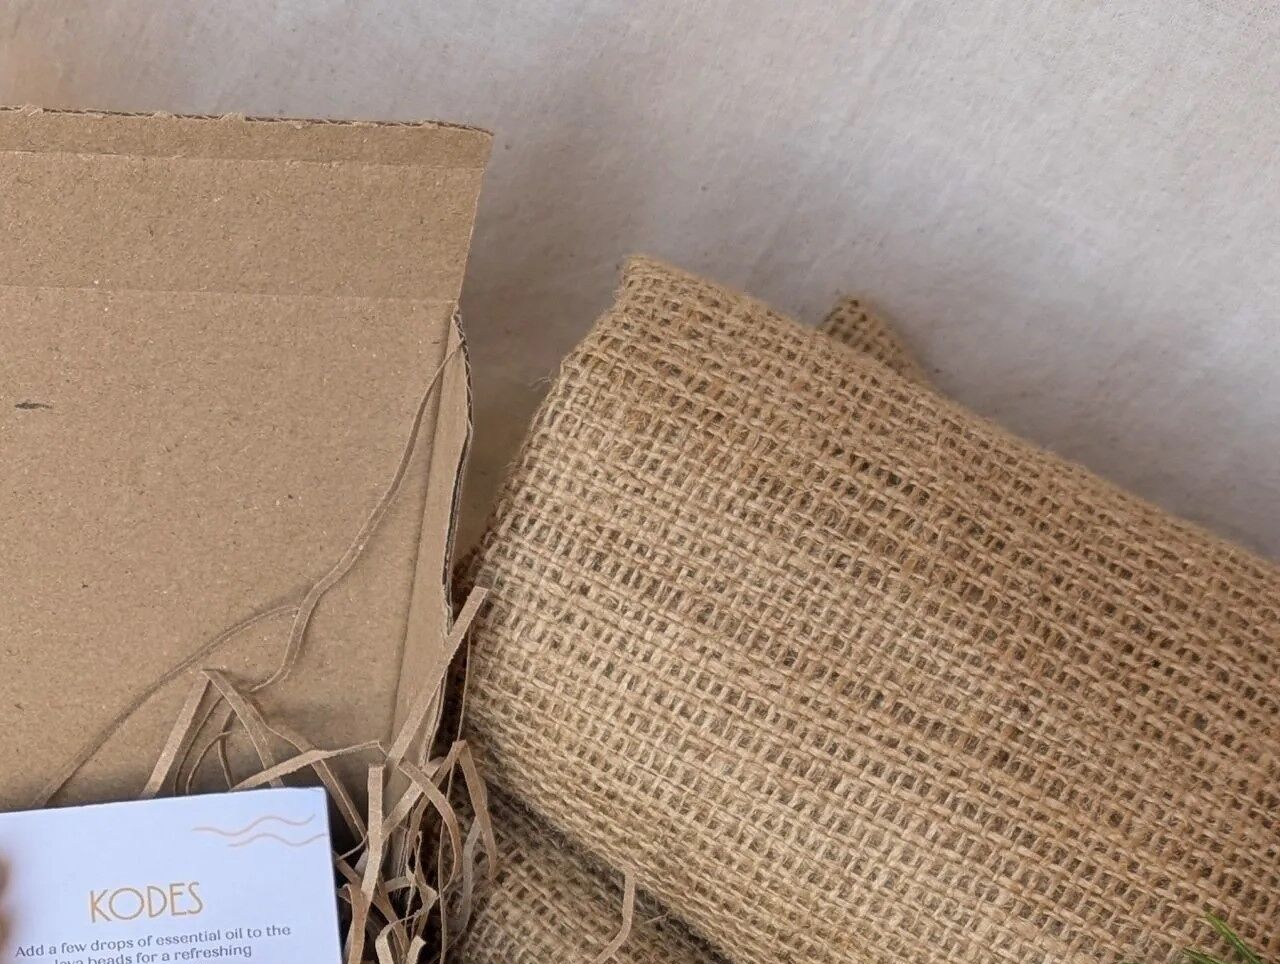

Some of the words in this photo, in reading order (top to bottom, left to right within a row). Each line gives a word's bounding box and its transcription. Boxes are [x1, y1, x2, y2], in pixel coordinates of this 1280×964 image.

[89, 880, 203, 923] KODES
[15, 944, 44, 956] Add
[48, 945, 56, 955] a
[61, 942, 87, 953] few
[90, 939, 133, 953] drops
[137, 934, 153, 947] of
[155, 928, 220, 945] essential
[225, 927, 242, 940] oil
[246, 928, 262, 938] to
[265, 924, 291, 936] the
[135, 951, 158, 964] for
[161, 952, 170, 961] a
[174, 944, 251, 960] refreshing
